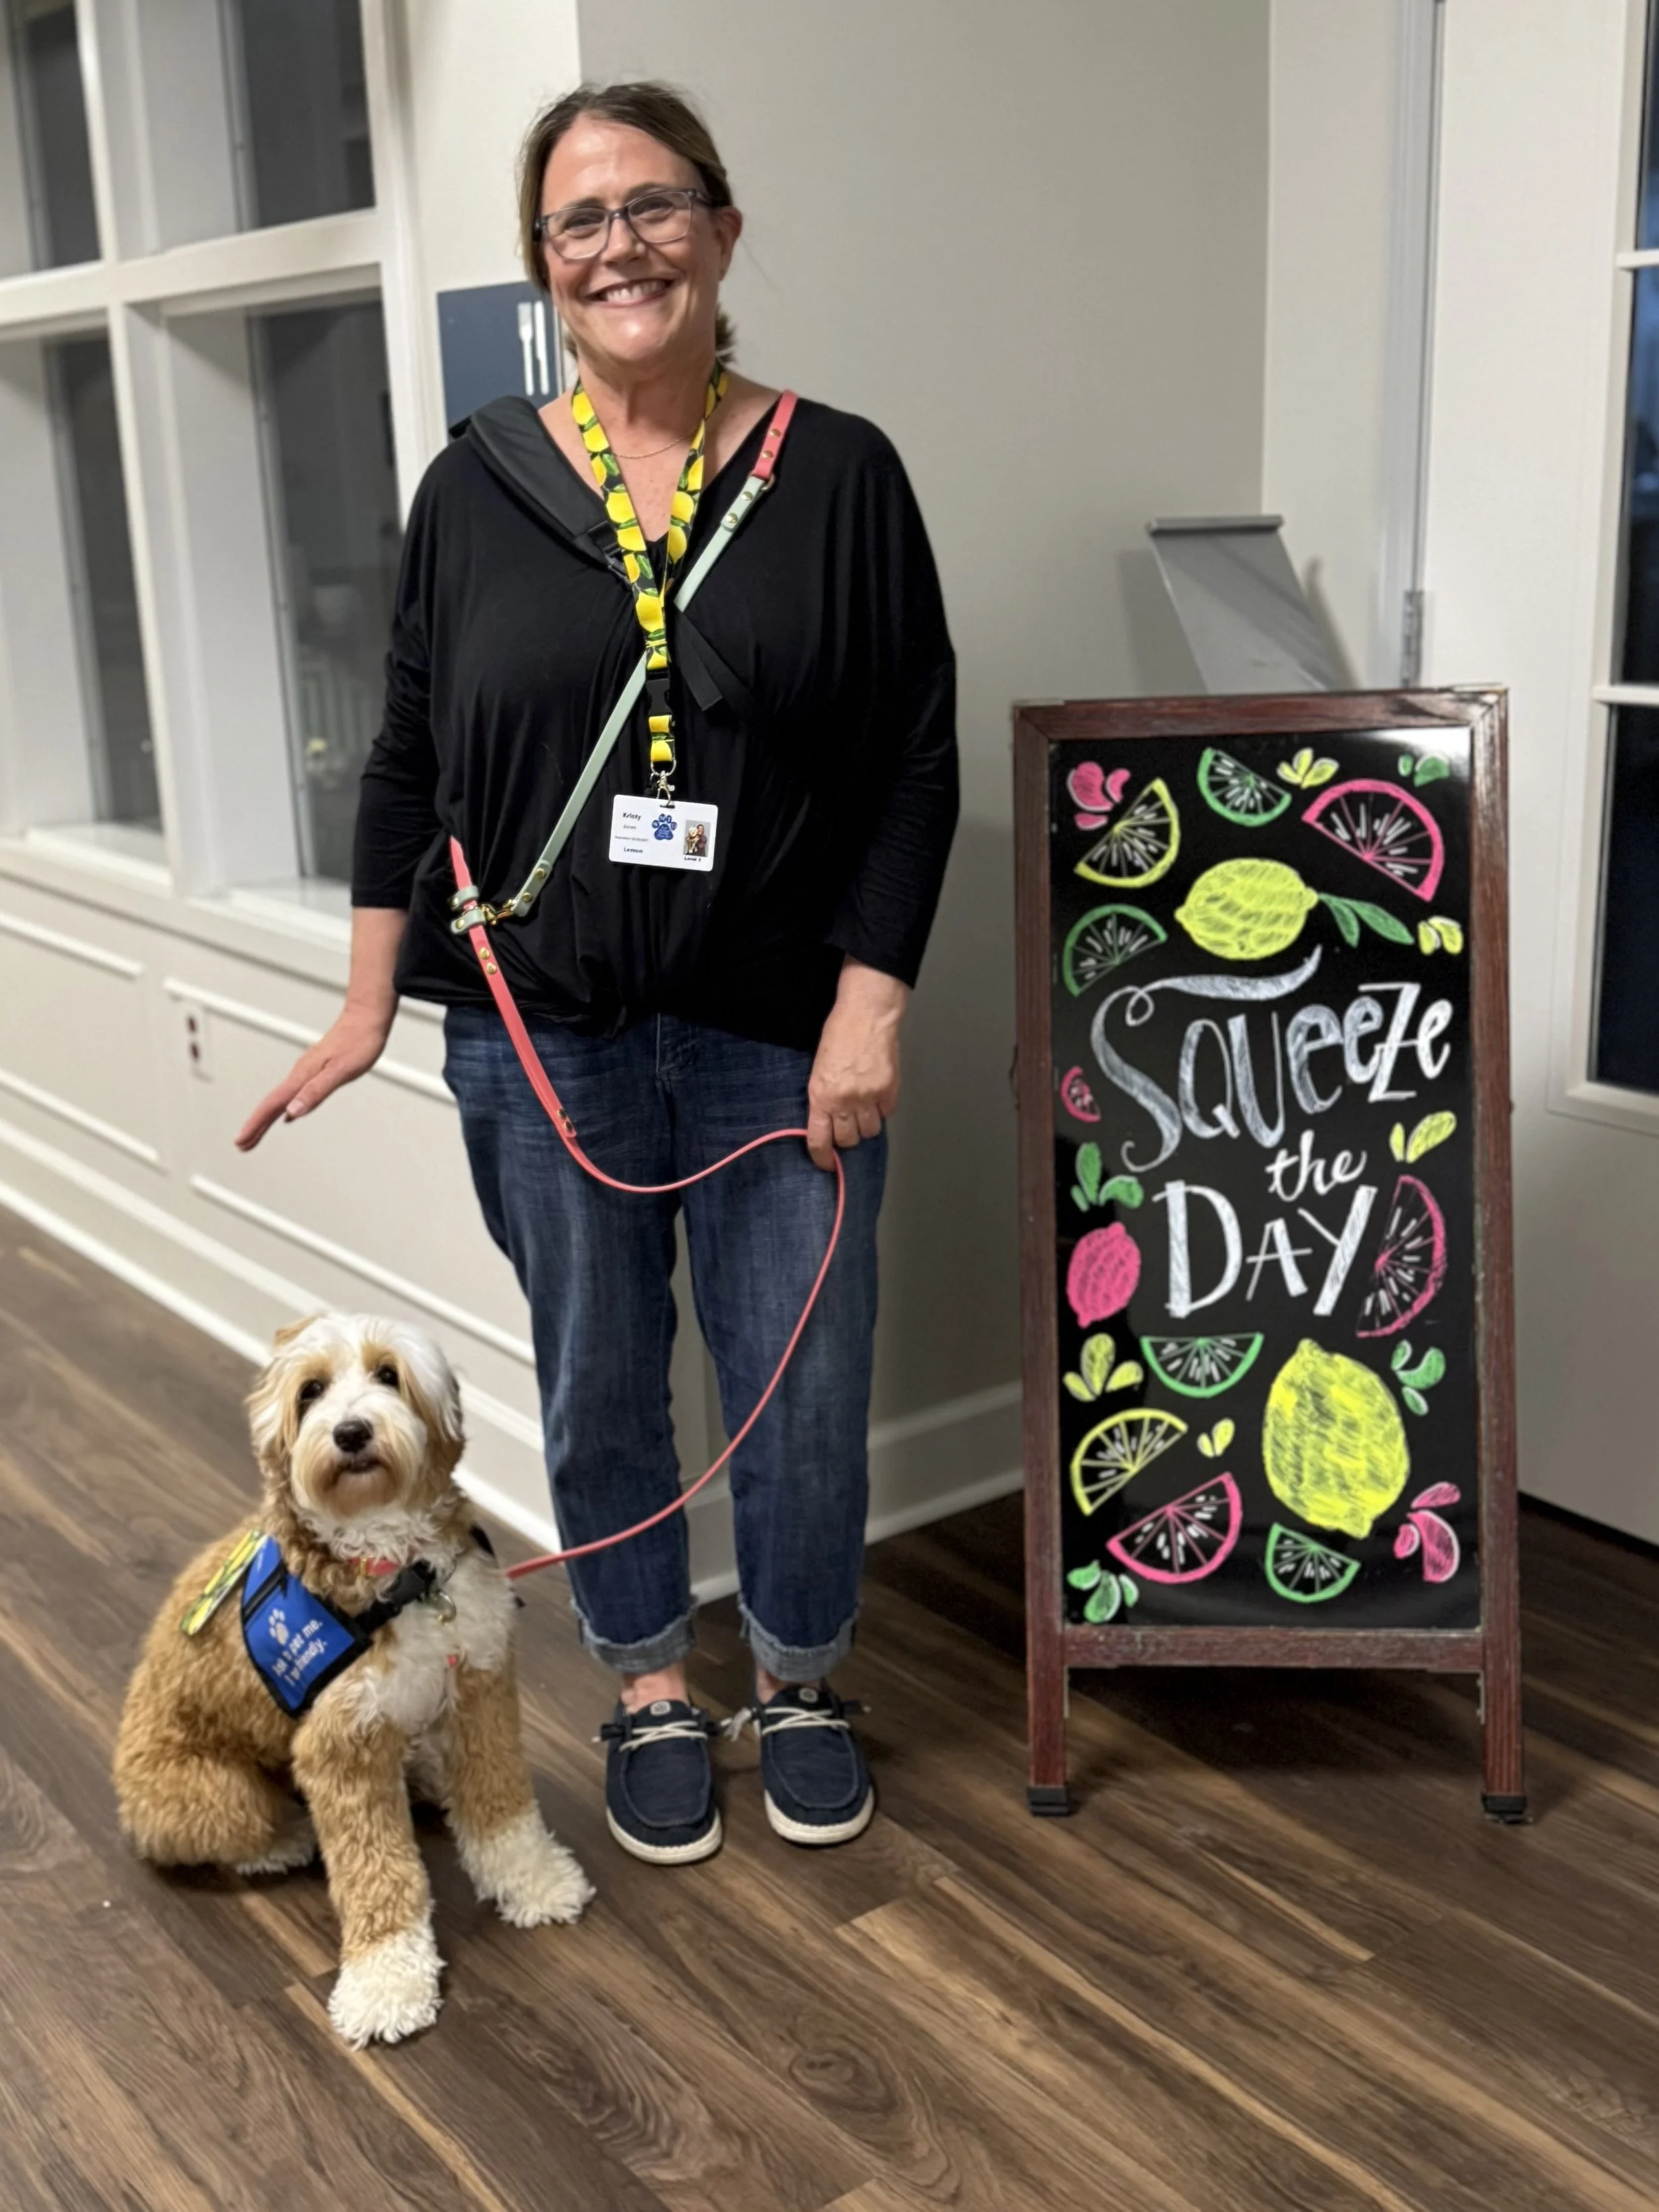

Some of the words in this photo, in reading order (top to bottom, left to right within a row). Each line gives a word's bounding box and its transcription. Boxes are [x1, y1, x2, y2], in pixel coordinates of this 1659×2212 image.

[1265, 1130, 1368, 1202] the
[1152, 1180, 1378, 1319] DAY
[289, 1633, 305, 1656] pet
